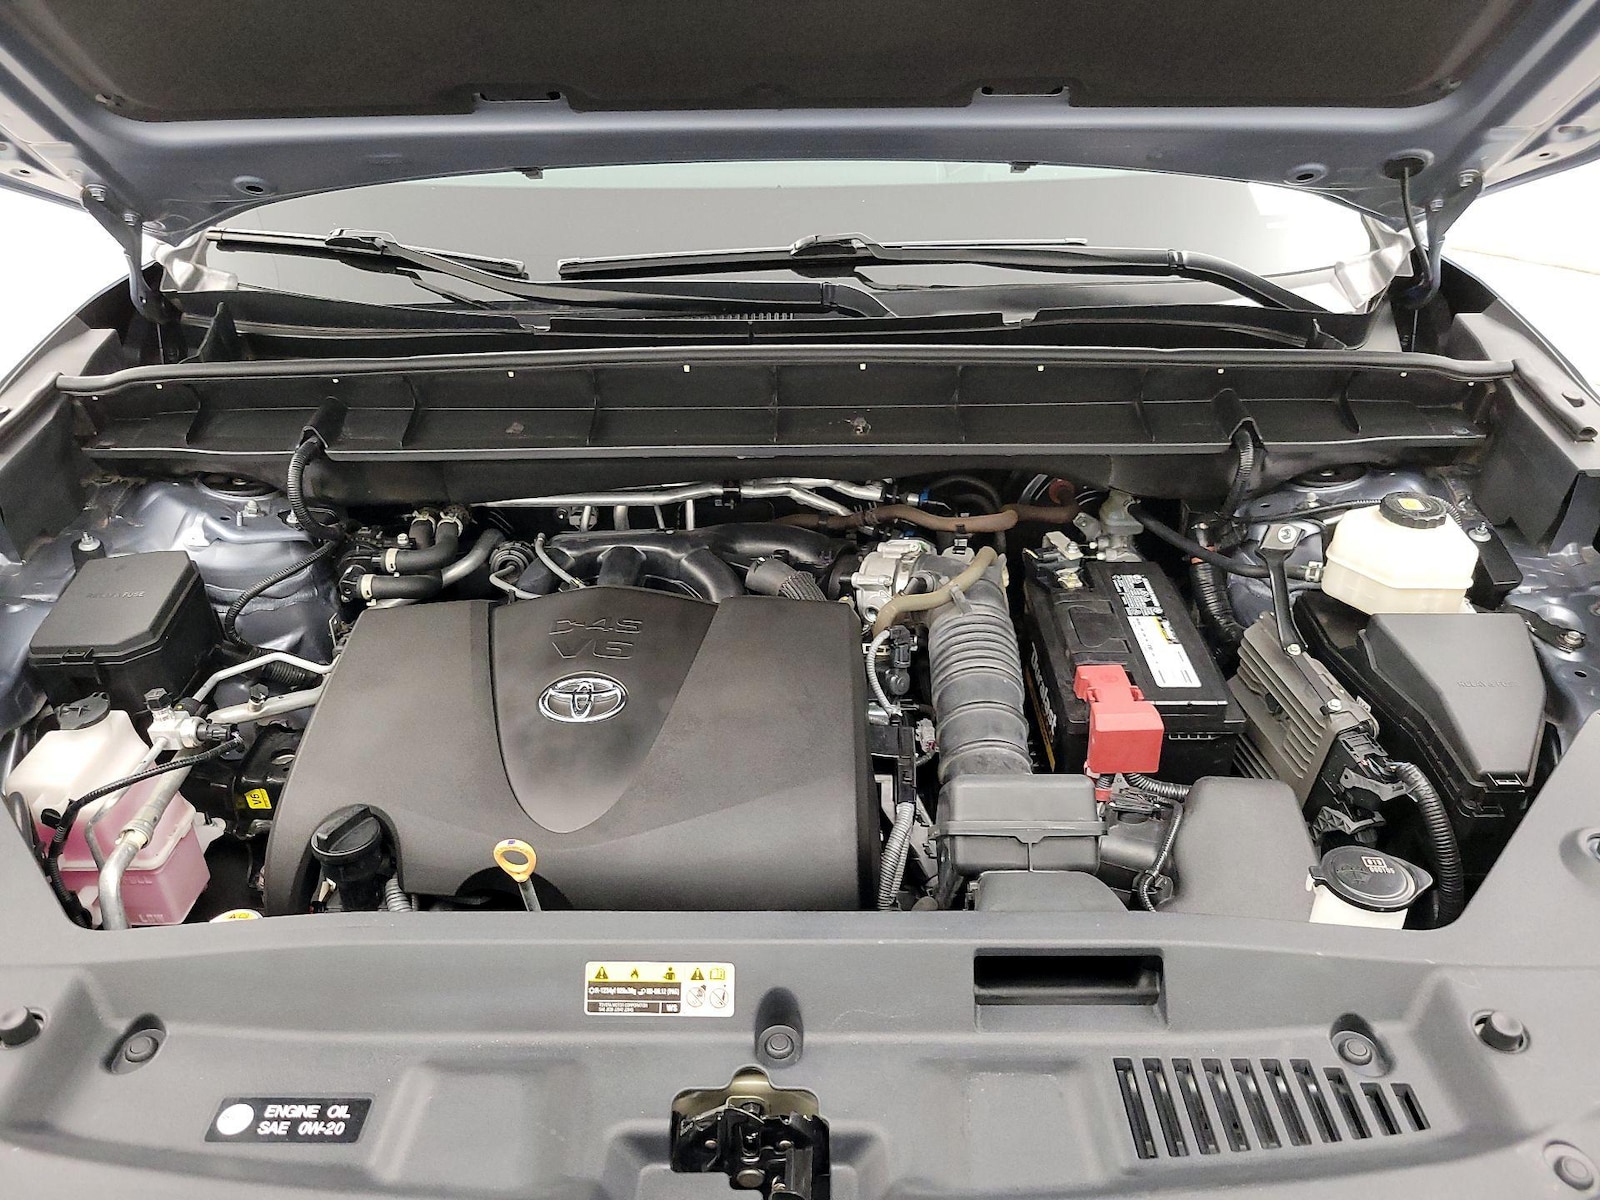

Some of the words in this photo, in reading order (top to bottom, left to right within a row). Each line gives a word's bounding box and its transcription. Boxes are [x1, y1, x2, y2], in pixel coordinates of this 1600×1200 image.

[551, 639, 634, 660] V6
[264, 1104, 321, 1118] ENGINE
[326, 1104, 351, 1119] OIL
[257, 1121, 291, 1136] SAE
[297, 1121, 346, 1136] 0W-20
